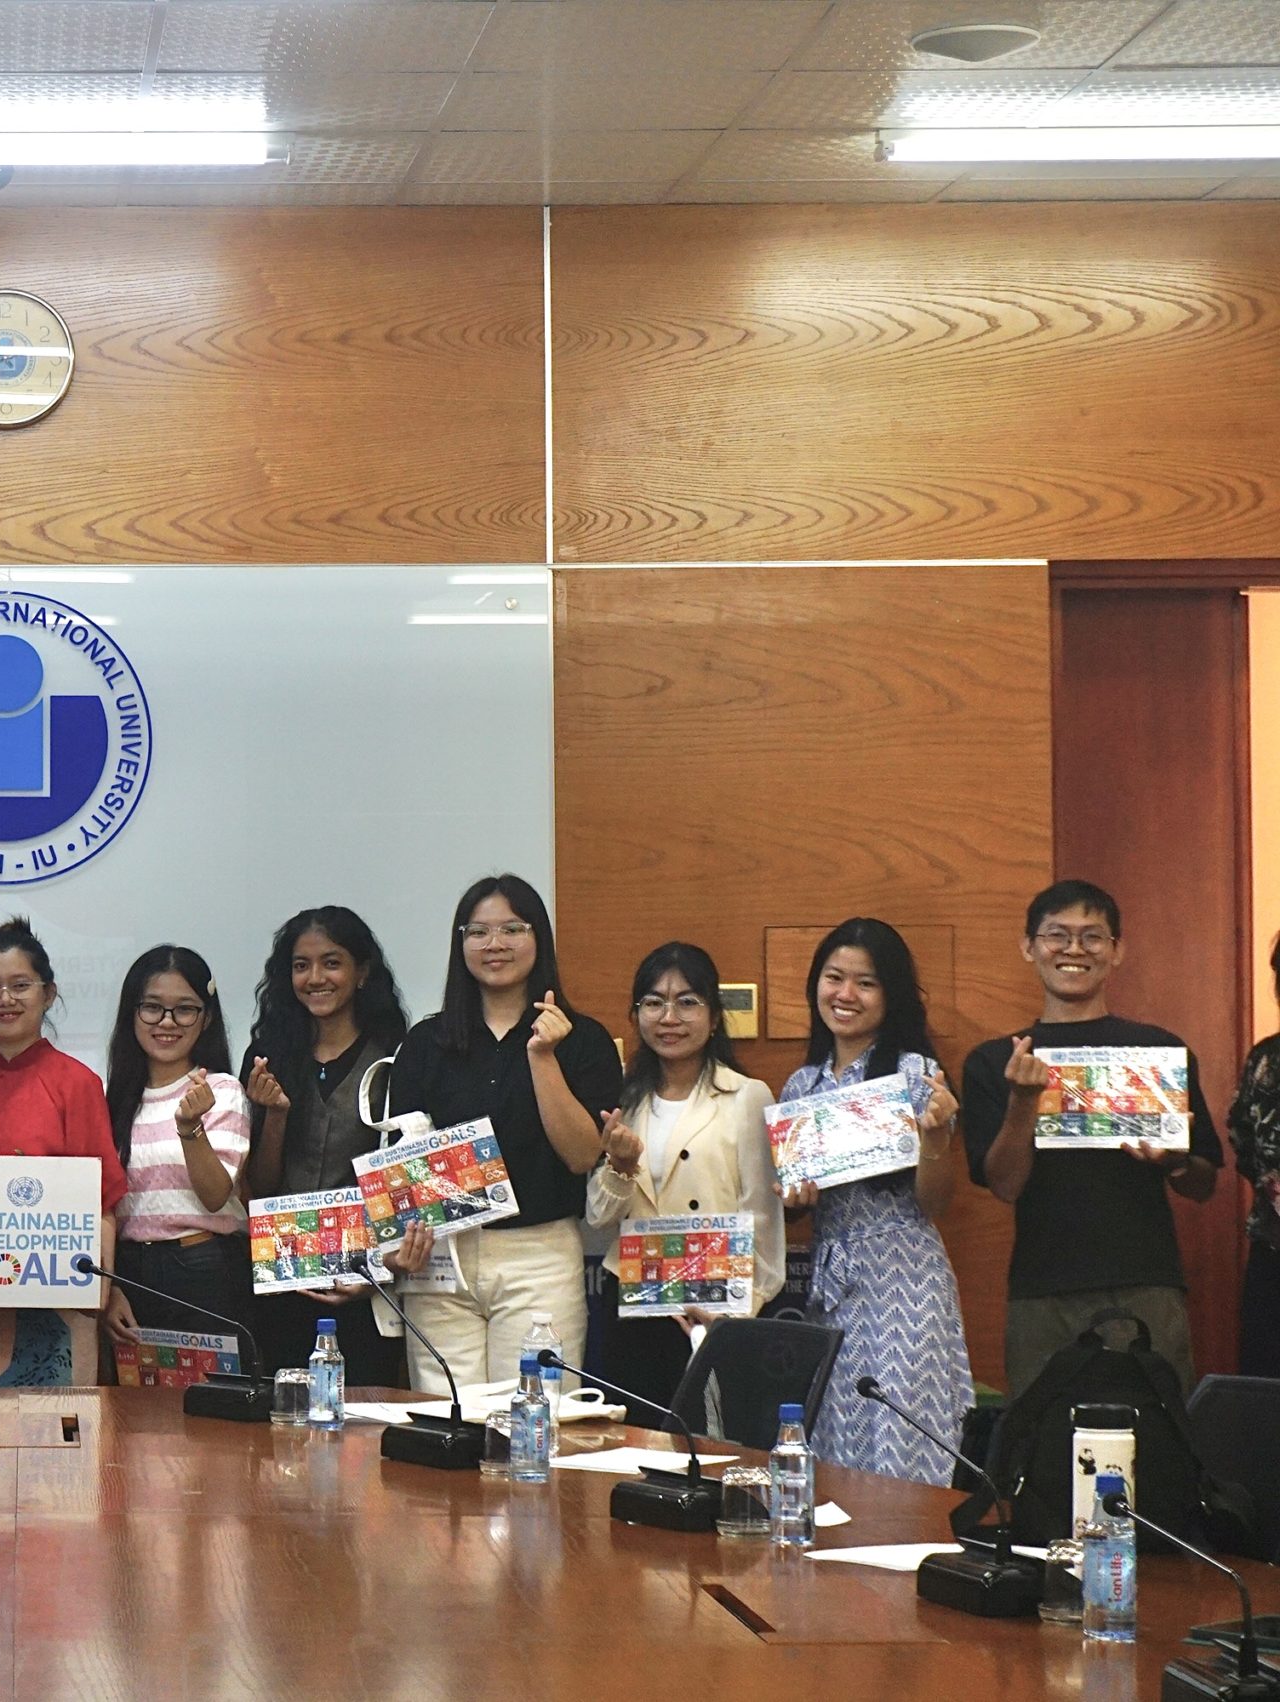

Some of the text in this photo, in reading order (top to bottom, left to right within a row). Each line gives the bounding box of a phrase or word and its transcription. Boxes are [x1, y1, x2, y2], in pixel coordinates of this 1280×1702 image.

[40, 326, 50, 343] 2
[42, 371, 52, 388] 4
[80, 694, 142, 847] UNIVERSITY
[31, 844, 58, 870] IU
[429, 1126, 476, 1149] GOALS
[324, 1190, 362, 1205] GOAL
[691, 1216, 737, 1230] GOALS
[181, 1334, 224, 1349] GOALS
